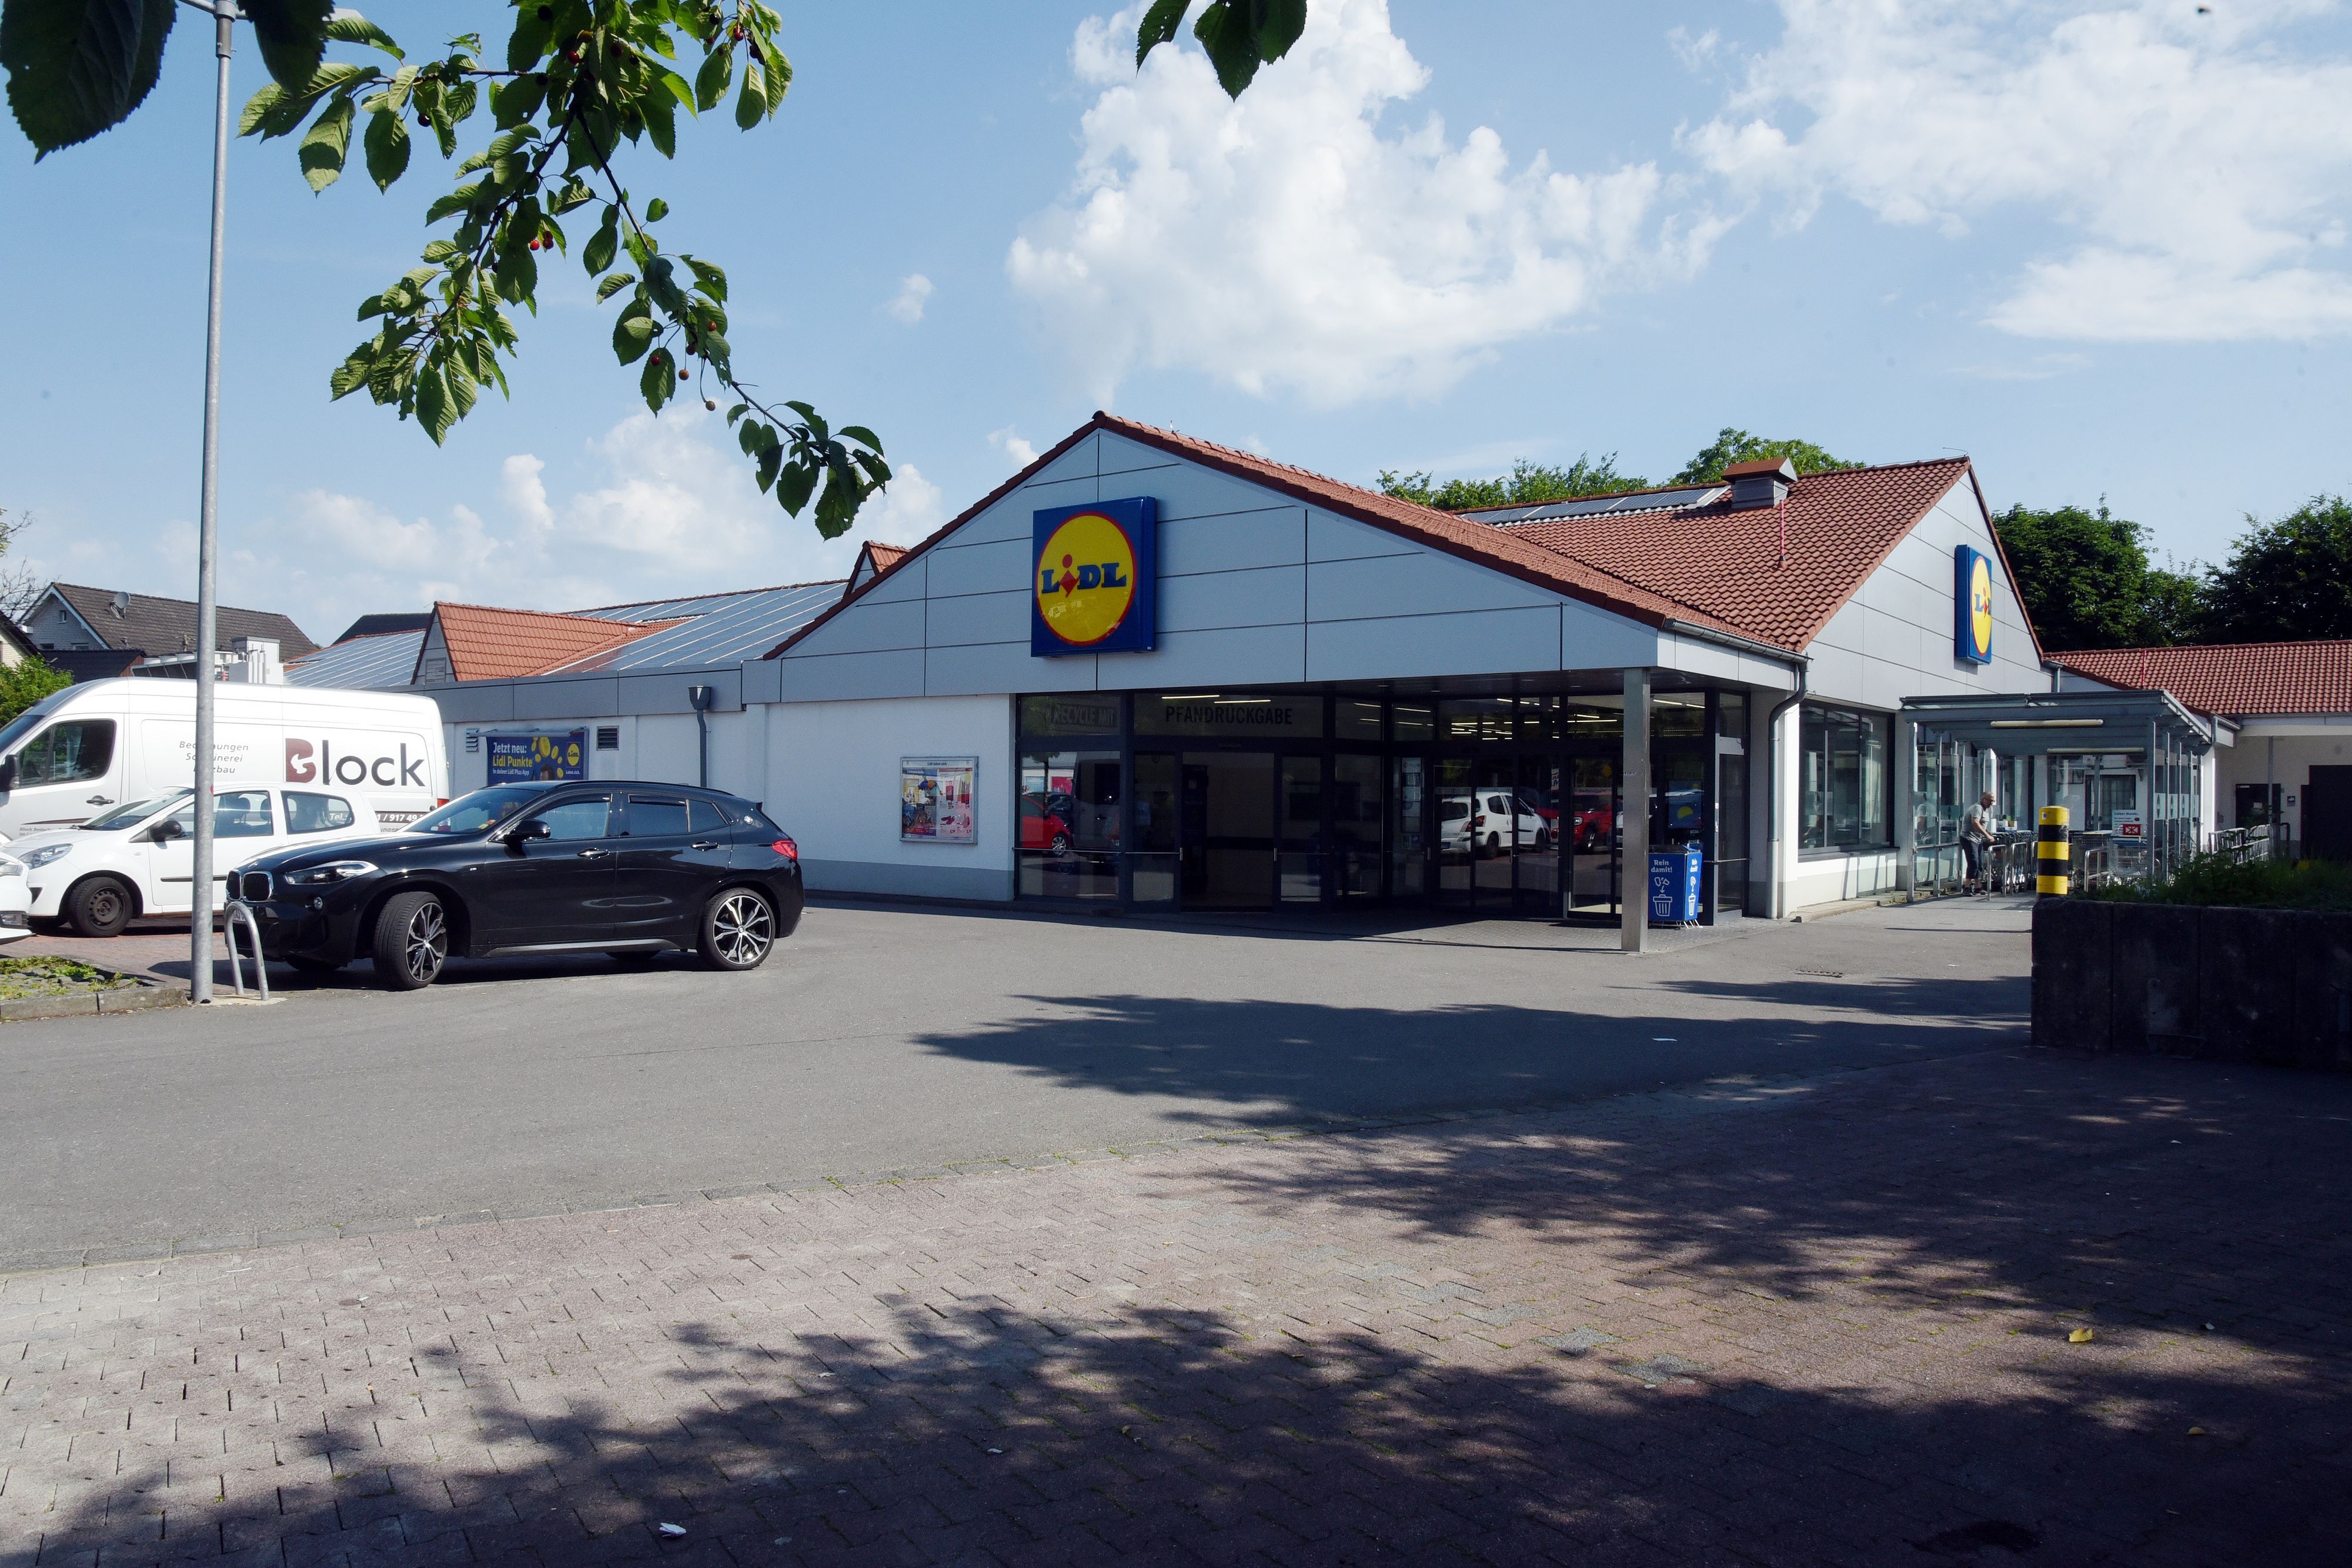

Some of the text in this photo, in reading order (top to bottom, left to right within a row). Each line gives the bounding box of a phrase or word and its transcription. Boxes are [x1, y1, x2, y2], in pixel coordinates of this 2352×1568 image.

[1165, 703, 1292, 725] PFANDRÜCKGABE
[493, 742, 527, 754] Jetzt neu:
[285, 738, 426, 787] Block
[493, 755, 506, 767] Lidl
[389, 814, 406, 822] 917
